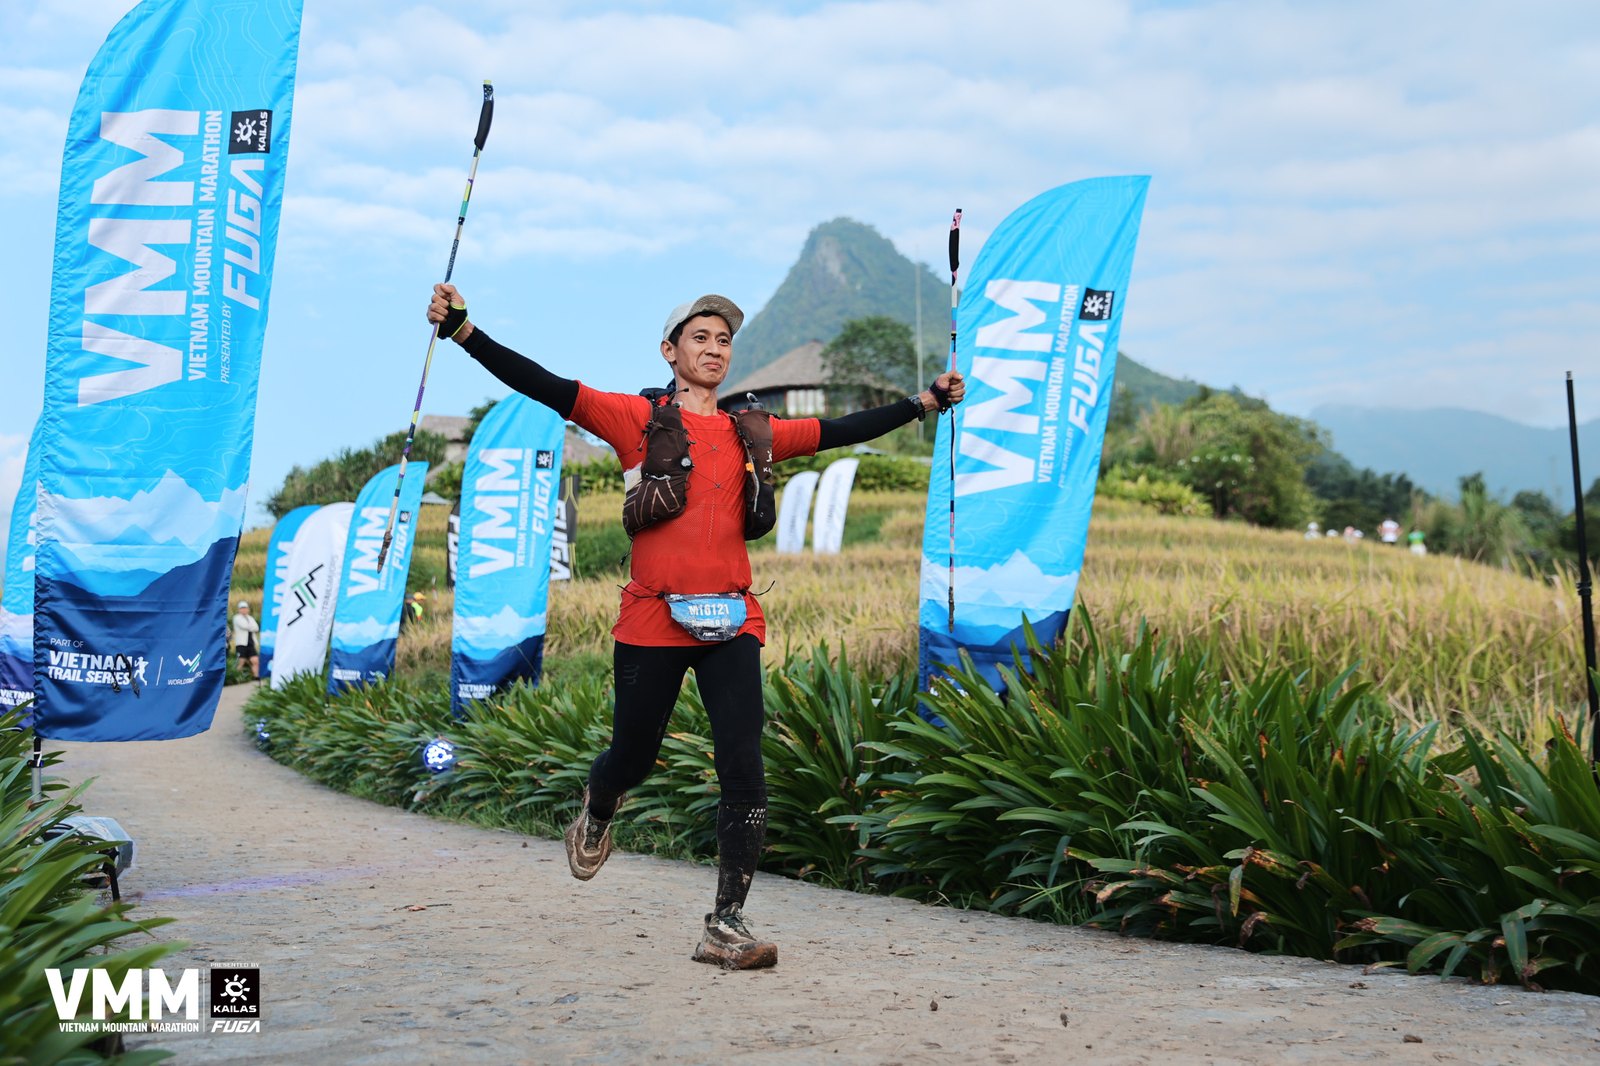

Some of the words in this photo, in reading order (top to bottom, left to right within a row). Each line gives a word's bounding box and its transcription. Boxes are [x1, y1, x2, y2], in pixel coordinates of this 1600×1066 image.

[199, 110, 222, 202] MARATHON
[257, 111, 269, 153] KAILAS
[77, 108, 200, 408] VMM
[192, 209, 215, 297] MOUNTAIN
[222, 159, 265, 311] FUGA
[221, 302, 232, 318] BY
[1054, 284, 1080, 353] MARATHON
[1102, 291, 1113, 320] KAILAS
[188, 303, 210, 382] VIETNAM
[220, 319, 232, 384] PRESENTED
[954, 278, 1061, 498] VMM
[1045, 357, 1066, 422] MOUNTAIN
[1068, 323, 1108, 435] FUGA
[1037, 426, 1057, 484] VIETNAM
[469, 448, 523, 580] VMM
[532, 470, 553, 536] FUGA
[347, 507, 392, 597] VMM
[688, 603, 730, 616] M16121
[48, 666, 83, 682] TRAIL
[85, 671, 131, 685] SERIES
[49, 650, 133, 671] VIETNAM
[50, 638, 71, 647] PART
[73, 640, 84, 648] OF
